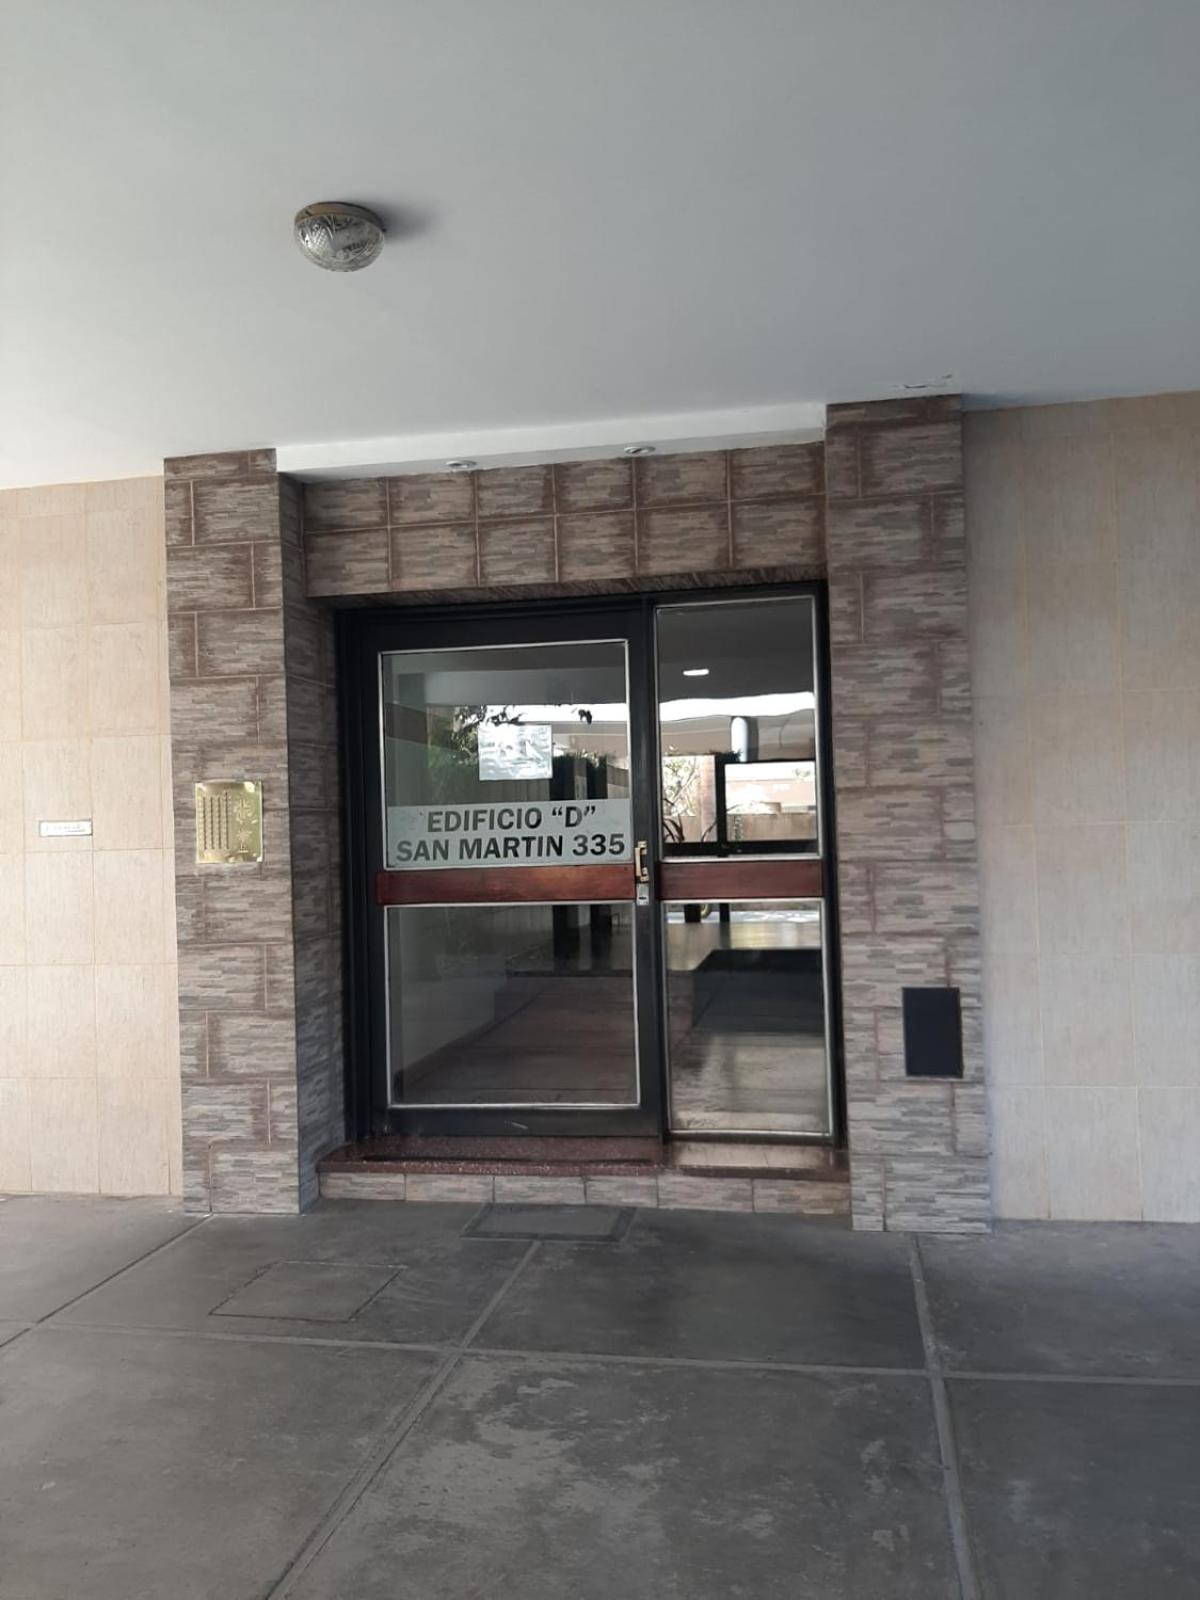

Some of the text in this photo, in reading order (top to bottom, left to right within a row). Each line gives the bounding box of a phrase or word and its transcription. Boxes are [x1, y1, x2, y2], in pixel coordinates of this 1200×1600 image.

[428, 808, 542, 833] EDIFICIO
[396, 833, 625, 862] SAN MARTIN 335
